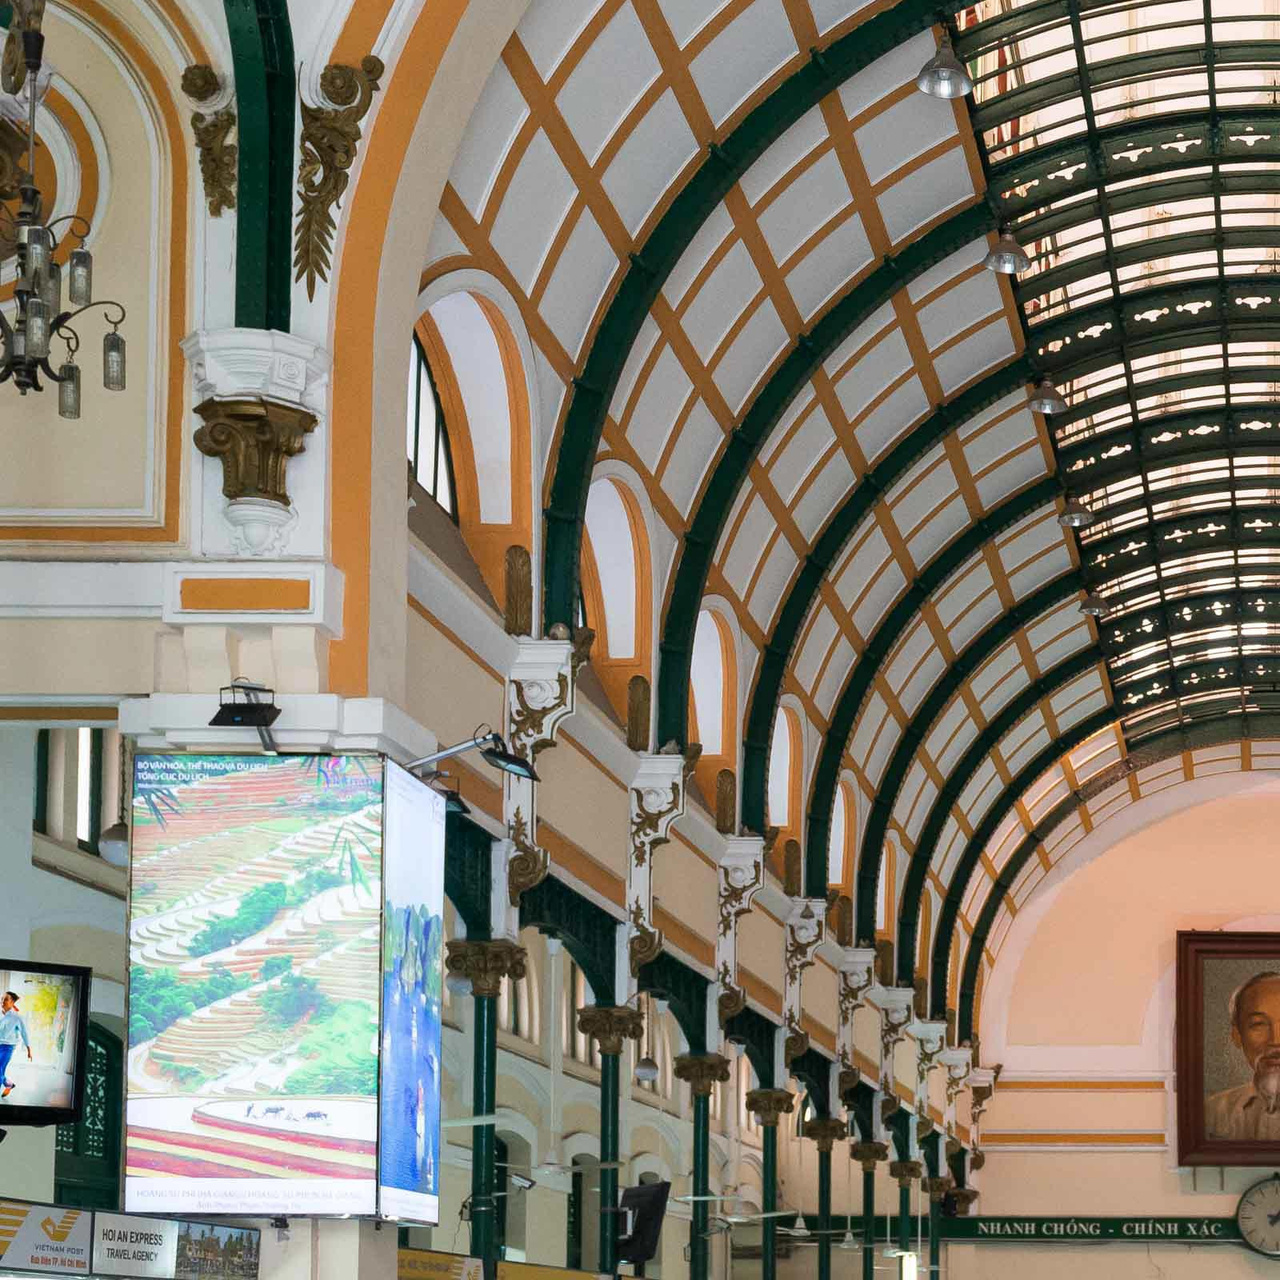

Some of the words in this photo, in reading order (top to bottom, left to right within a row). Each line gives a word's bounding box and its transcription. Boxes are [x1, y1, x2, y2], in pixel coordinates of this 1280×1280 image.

[978, 1222, 1036, 1234] NHANH
[1042, 1219, 1101, 1235] CHÓNG
[1122, 1220, 1178, 1235] CHÍNH
[1187, 1220, 1222, 1236] XÁC
[102, 1228, 116, 1242] HOI
[117, 1230, 128, 1243] AN
[129, 1231, 163, 1246] EXPRESS
[34, 1244, 65, 1253] VIETNAM
[66, 1247, 84, 1255] POST
[106, 1248, 131, 1260] TRAVEL
[132, 1250, 158, 1262] AGENCY
